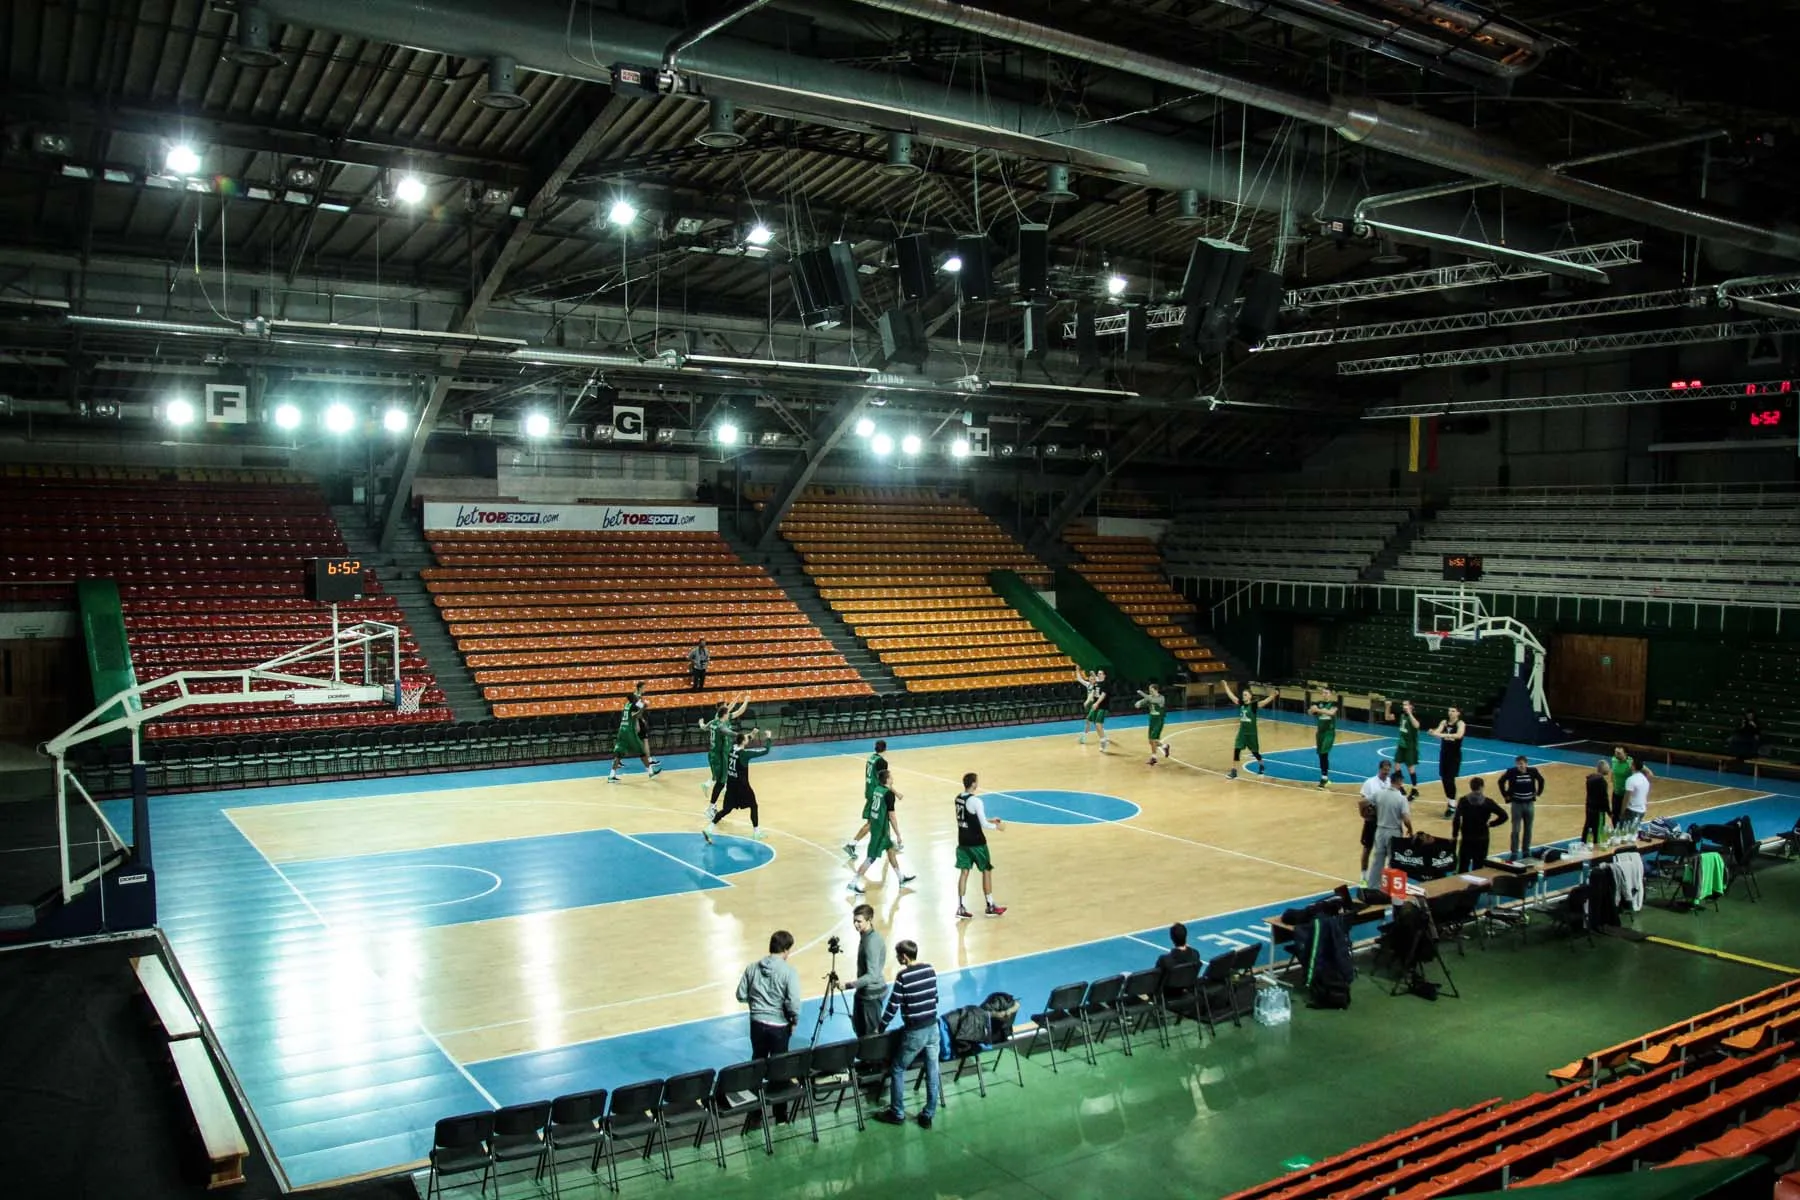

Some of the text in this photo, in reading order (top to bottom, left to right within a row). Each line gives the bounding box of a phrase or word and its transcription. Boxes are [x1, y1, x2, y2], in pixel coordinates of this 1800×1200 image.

[213, 390, 240, 416] F
[615, 411, 642, 434] G
[1750, 410, 1780, 425] 6:52
[969, 432, 988, 452] H
[456, 505, 560, 528] betTOPsport.com
[602, 507, 696, 529] betTOPsport.com
[328, 561, 360, 575] 6:52
[1381, 873, 1389, 888] 5
[1392, 876, 1404, 890] 5
